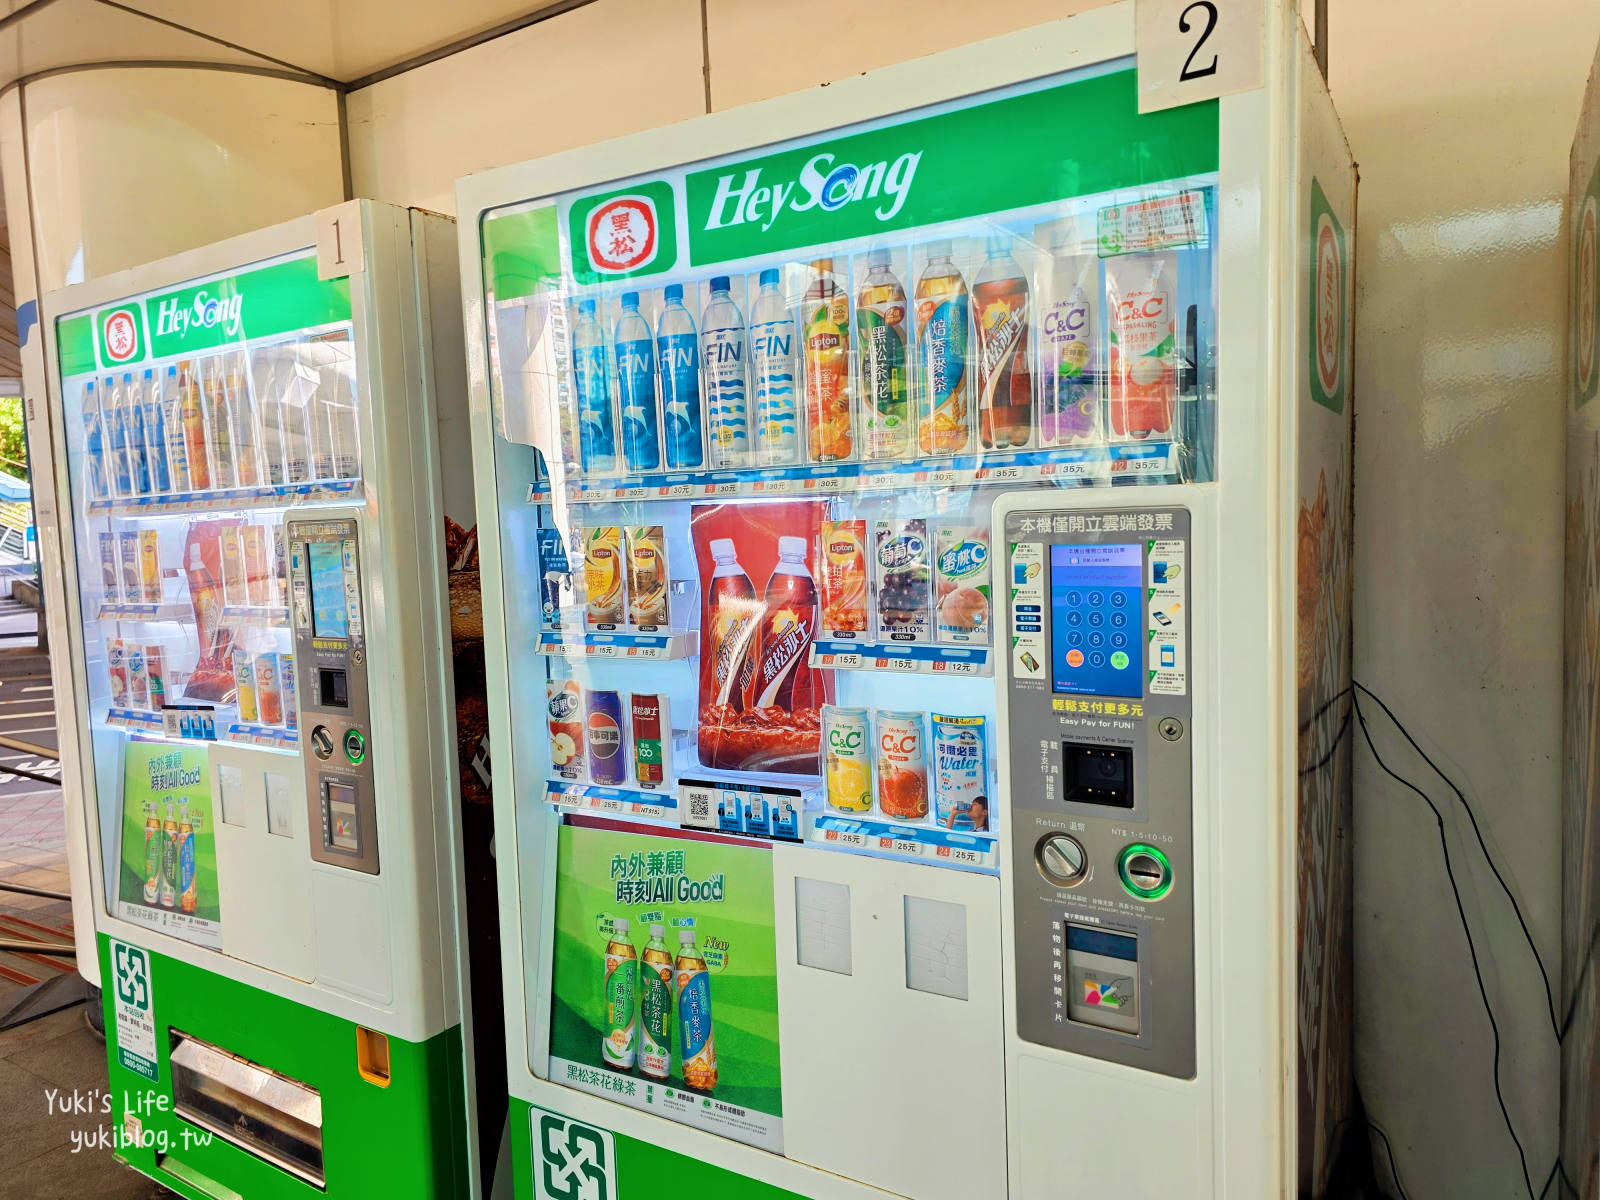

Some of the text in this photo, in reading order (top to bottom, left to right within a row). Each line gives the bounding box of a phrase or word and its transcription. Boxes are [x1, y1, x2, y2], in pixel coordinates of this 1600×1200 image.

[1179, 1, 1218, 82] 2
[704, 151, 923, 232] HeySong
[609, 212, 636, 256] 黑松
[332, 218, 345, 265] 1
[156, 291, 243, 338] HeySong
[1116, 297, 1163, 321] C&C
[1044, 308, 1085, 335] C&C
[755, 334, 791, 359] FIN
[811, 337, 837, 347] Lipton
[662, 347, 693, 369] FIN
[706, 341, 742, 365] FIN
[618, 353, 649, 374] FIN
[1062, 463, 1085, 474] 35元
[1135, 459, 1158, 469] 35元
[673, 486, 689, 494] 30元
[720, 484, 736, 492] 30元
[820, 479, 838, 488] 30元
[1019, 513, 1174, 534] 本機僅開立雲端發票
[831, 544, 854, 553] Lipton
[1092, 595, 1099, 604] 2
[1115, 595, 1122, 604] 3
[1070, 614, 1122, 625] 4 5 6
[1071, 634, 1122, 645] 7 8 9
[763, 619, 810, 684] 黑松沙士
[839, 655, 857, 664] 15元
[876, 659, 888, 668] 17
[894, 659, 913, 669] 15元
[1093, 654, 1101, 664] 0
[933, 661, 945, 671] 18
[952, 662, 971, 672] 12元
[1052, 699, 1144, 717] 輕鬆支付更多元
[1060, 717, 1135, 730] Easy Pay for FUN!
[829, 730, 862, 748] C&C
[881, 734, 916, 753] C&C
[639, 748, 653, 758] 100
[939, 743, 978, 756] 可爾必思
[940, 756, 979, 770] Water
[179, 765, 201, 787] Good
[1035, 817, 1066, 830] Return
[842, 834, 861, 844] 25元
[898, 842, 916, 852] 25元
[938, 847, 949, 856] 24
[955, 850, 976, 861] 25元
[610, 849, 685, 879] 內外兼顧
[677, 873, 724, 902] Good
[703, 936, 730, 951] New
[651, 979, 661, 1033] 黑松茶花
[688, 988, 702, 1042] 焙香麥茶
[567, 1064, 637, 1097] 黑松茶花綠茶
